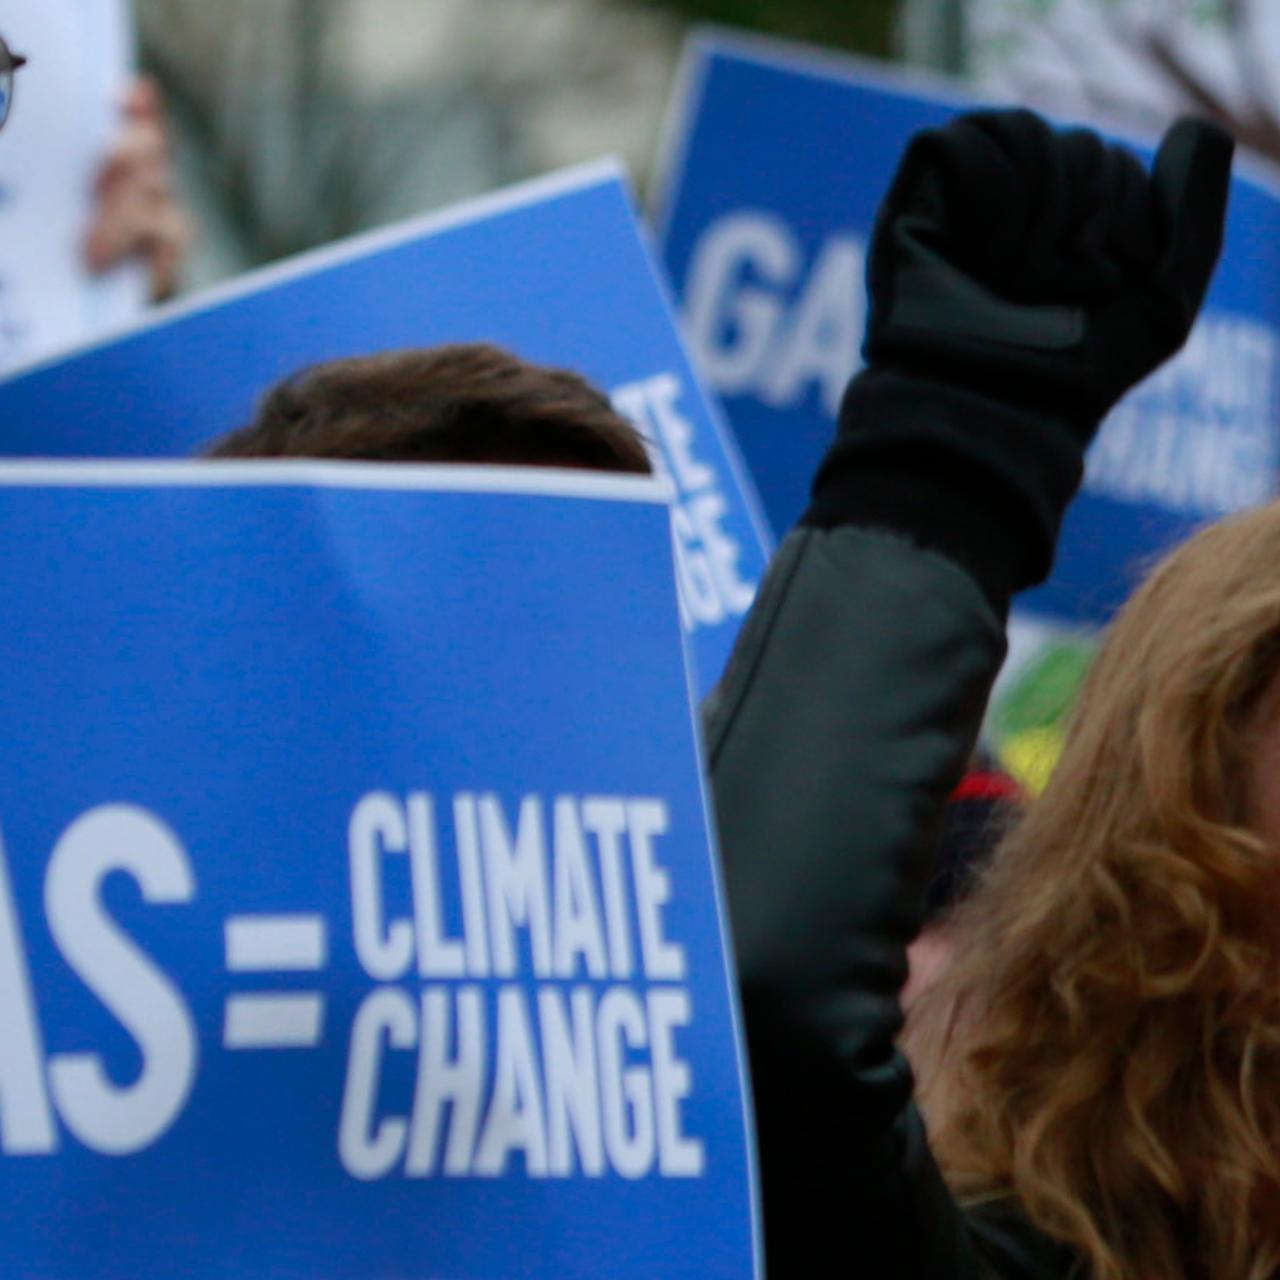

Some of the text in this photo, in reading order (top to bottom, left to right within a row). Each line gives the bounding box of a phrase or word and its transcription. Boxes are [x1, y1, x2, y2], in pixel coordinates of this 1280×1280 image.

[684, 212, 868, 412] GA
[348, 792, 686, 981] CLIMATE
[339, 986, 704, 1181] CHANGE
